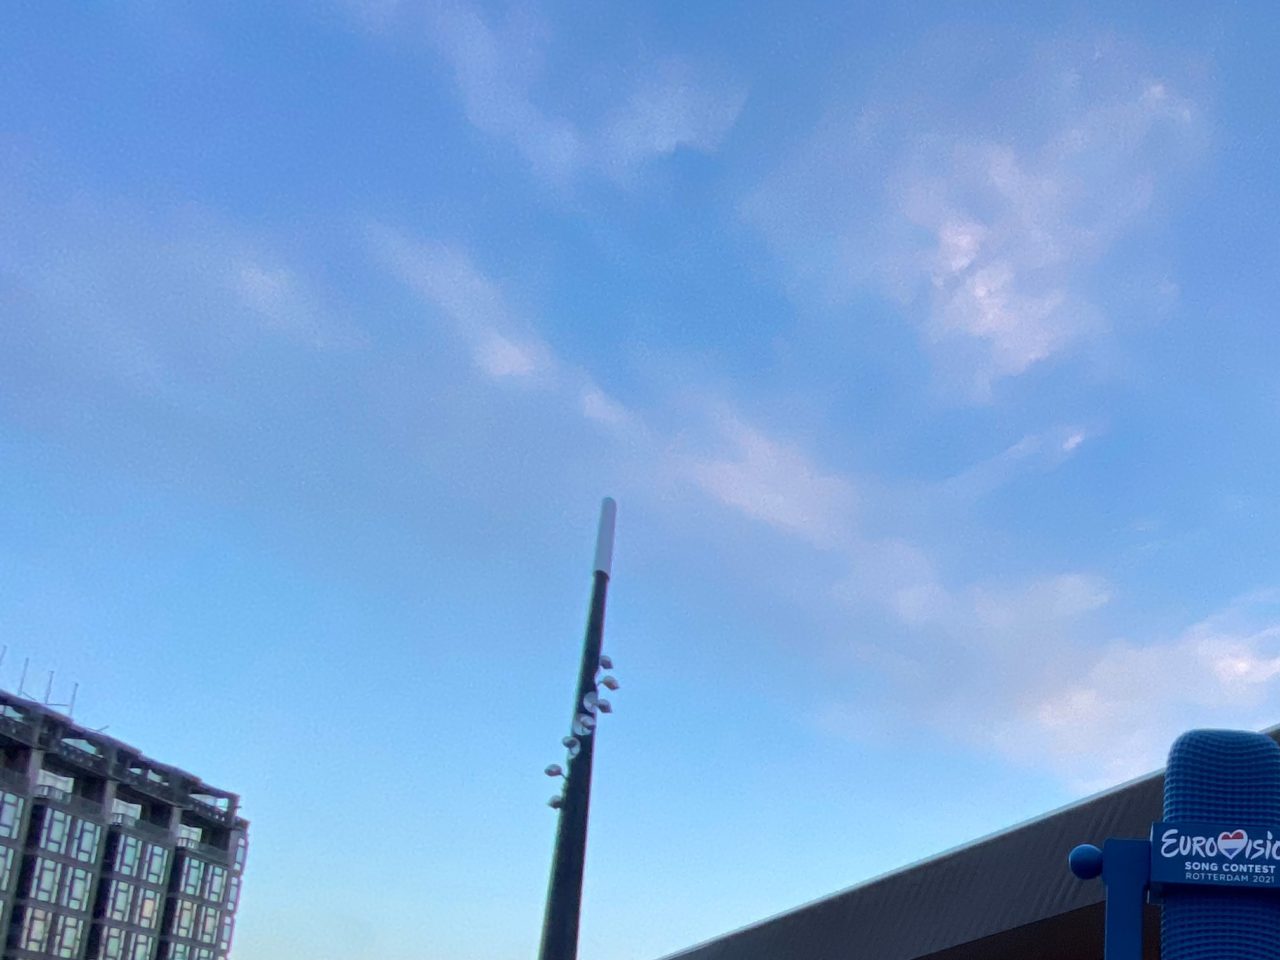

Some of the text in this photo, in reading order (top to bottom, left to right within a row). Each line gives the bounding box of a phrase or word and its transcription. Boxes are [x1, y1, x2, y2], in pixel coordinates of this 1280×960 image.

[1184, 861, 1276, 874] SONG CONTEST
[1185, 872, 1275, 883] ROTTERDAM 2021
